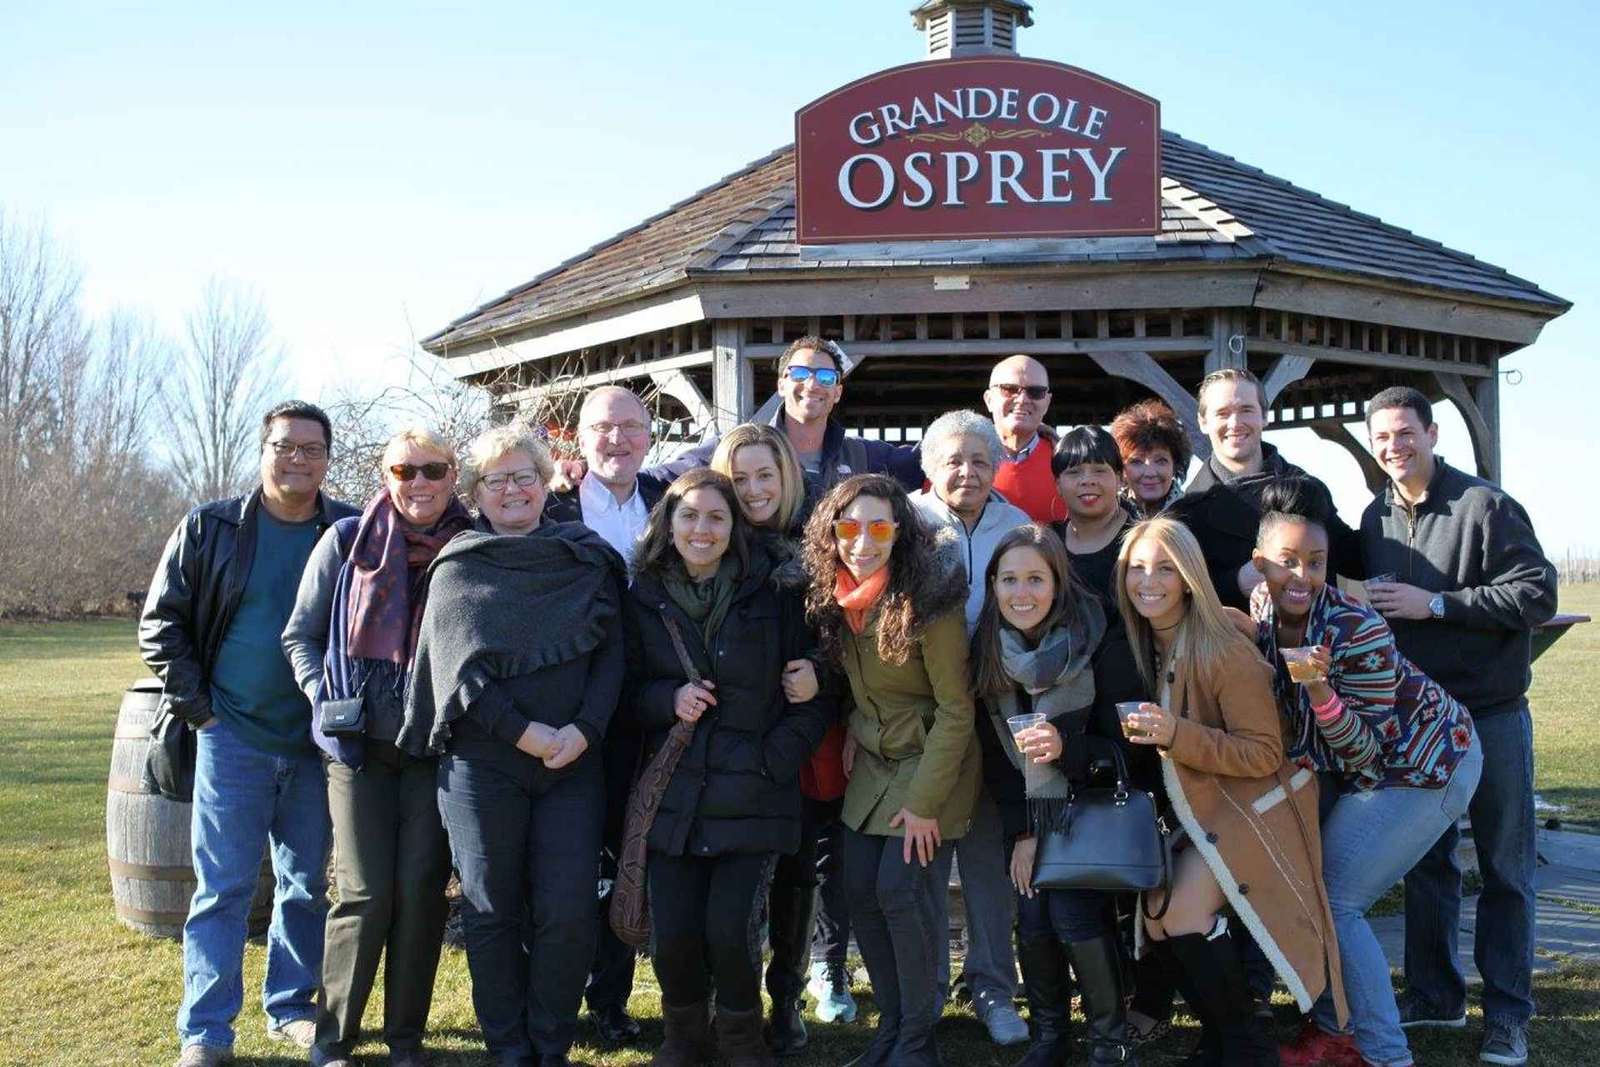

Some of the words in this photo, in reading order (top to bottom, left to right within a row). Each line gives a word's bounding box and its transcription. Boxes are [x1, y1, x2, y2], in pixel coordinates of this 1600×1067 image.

[848, 87, 1019, 145] GRANDE
[1027, 92, 1108, 139] OLE
[838, 147, 1127, 209] OSPREY
